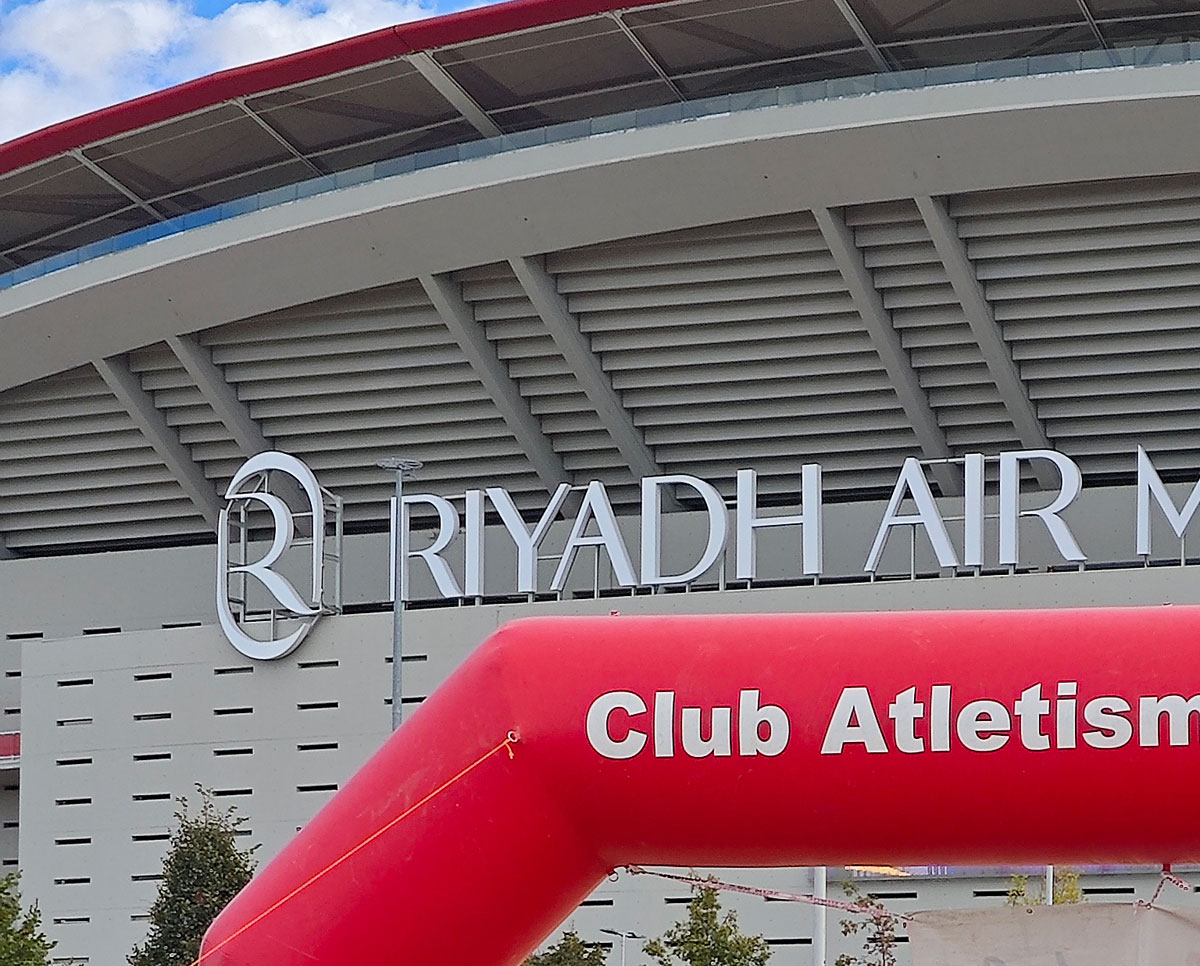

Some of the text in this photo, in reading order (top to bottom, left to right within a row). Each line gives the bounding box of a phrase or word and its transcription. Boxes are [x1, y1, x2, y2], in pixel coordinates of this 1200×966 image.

[389, 465, 823, 602] RIYADH
[863, 449, 1087, 572] AIR
[586, 689, 790, 759] Club
